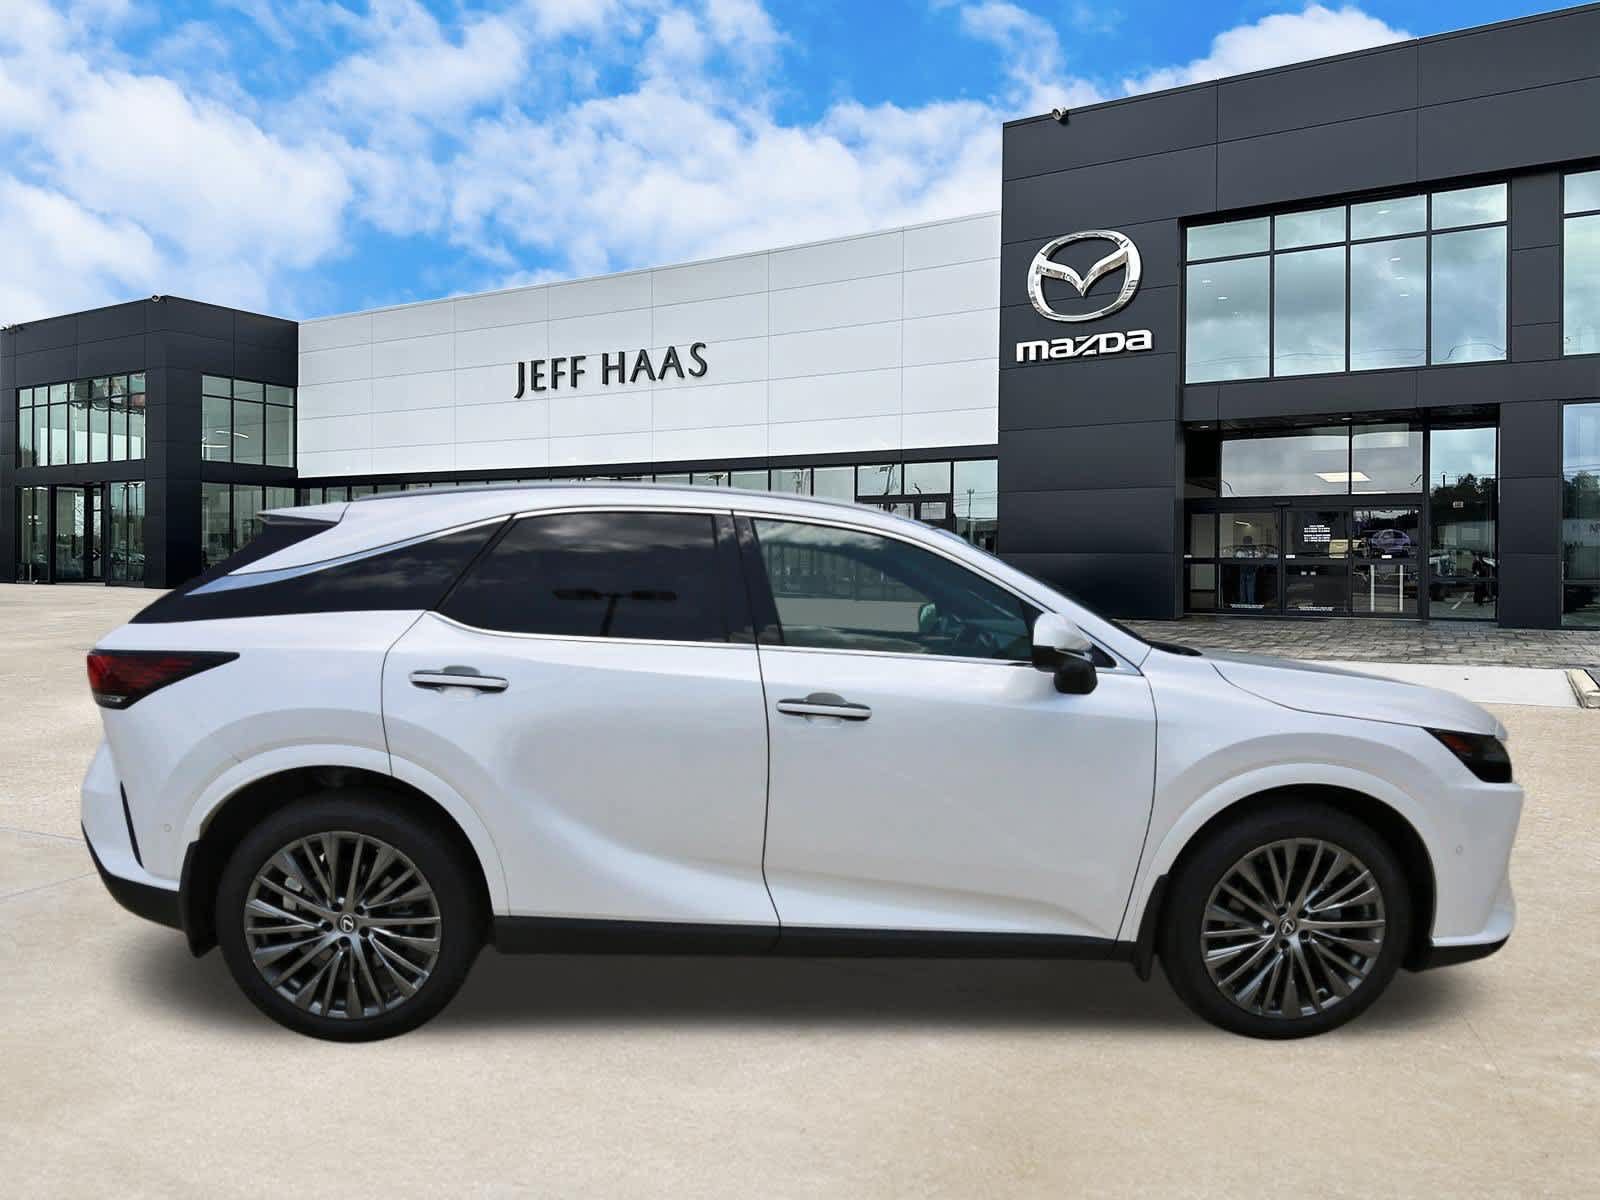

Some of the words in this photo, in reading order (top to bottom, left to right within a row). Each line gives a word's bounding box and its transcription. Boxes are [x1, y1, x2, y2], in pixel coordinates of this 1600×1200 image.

[1016, 329, 1153, 362] mazda
[514, 355, 587, 399] JEFF
[601, 342, 708, 386] HAAS
